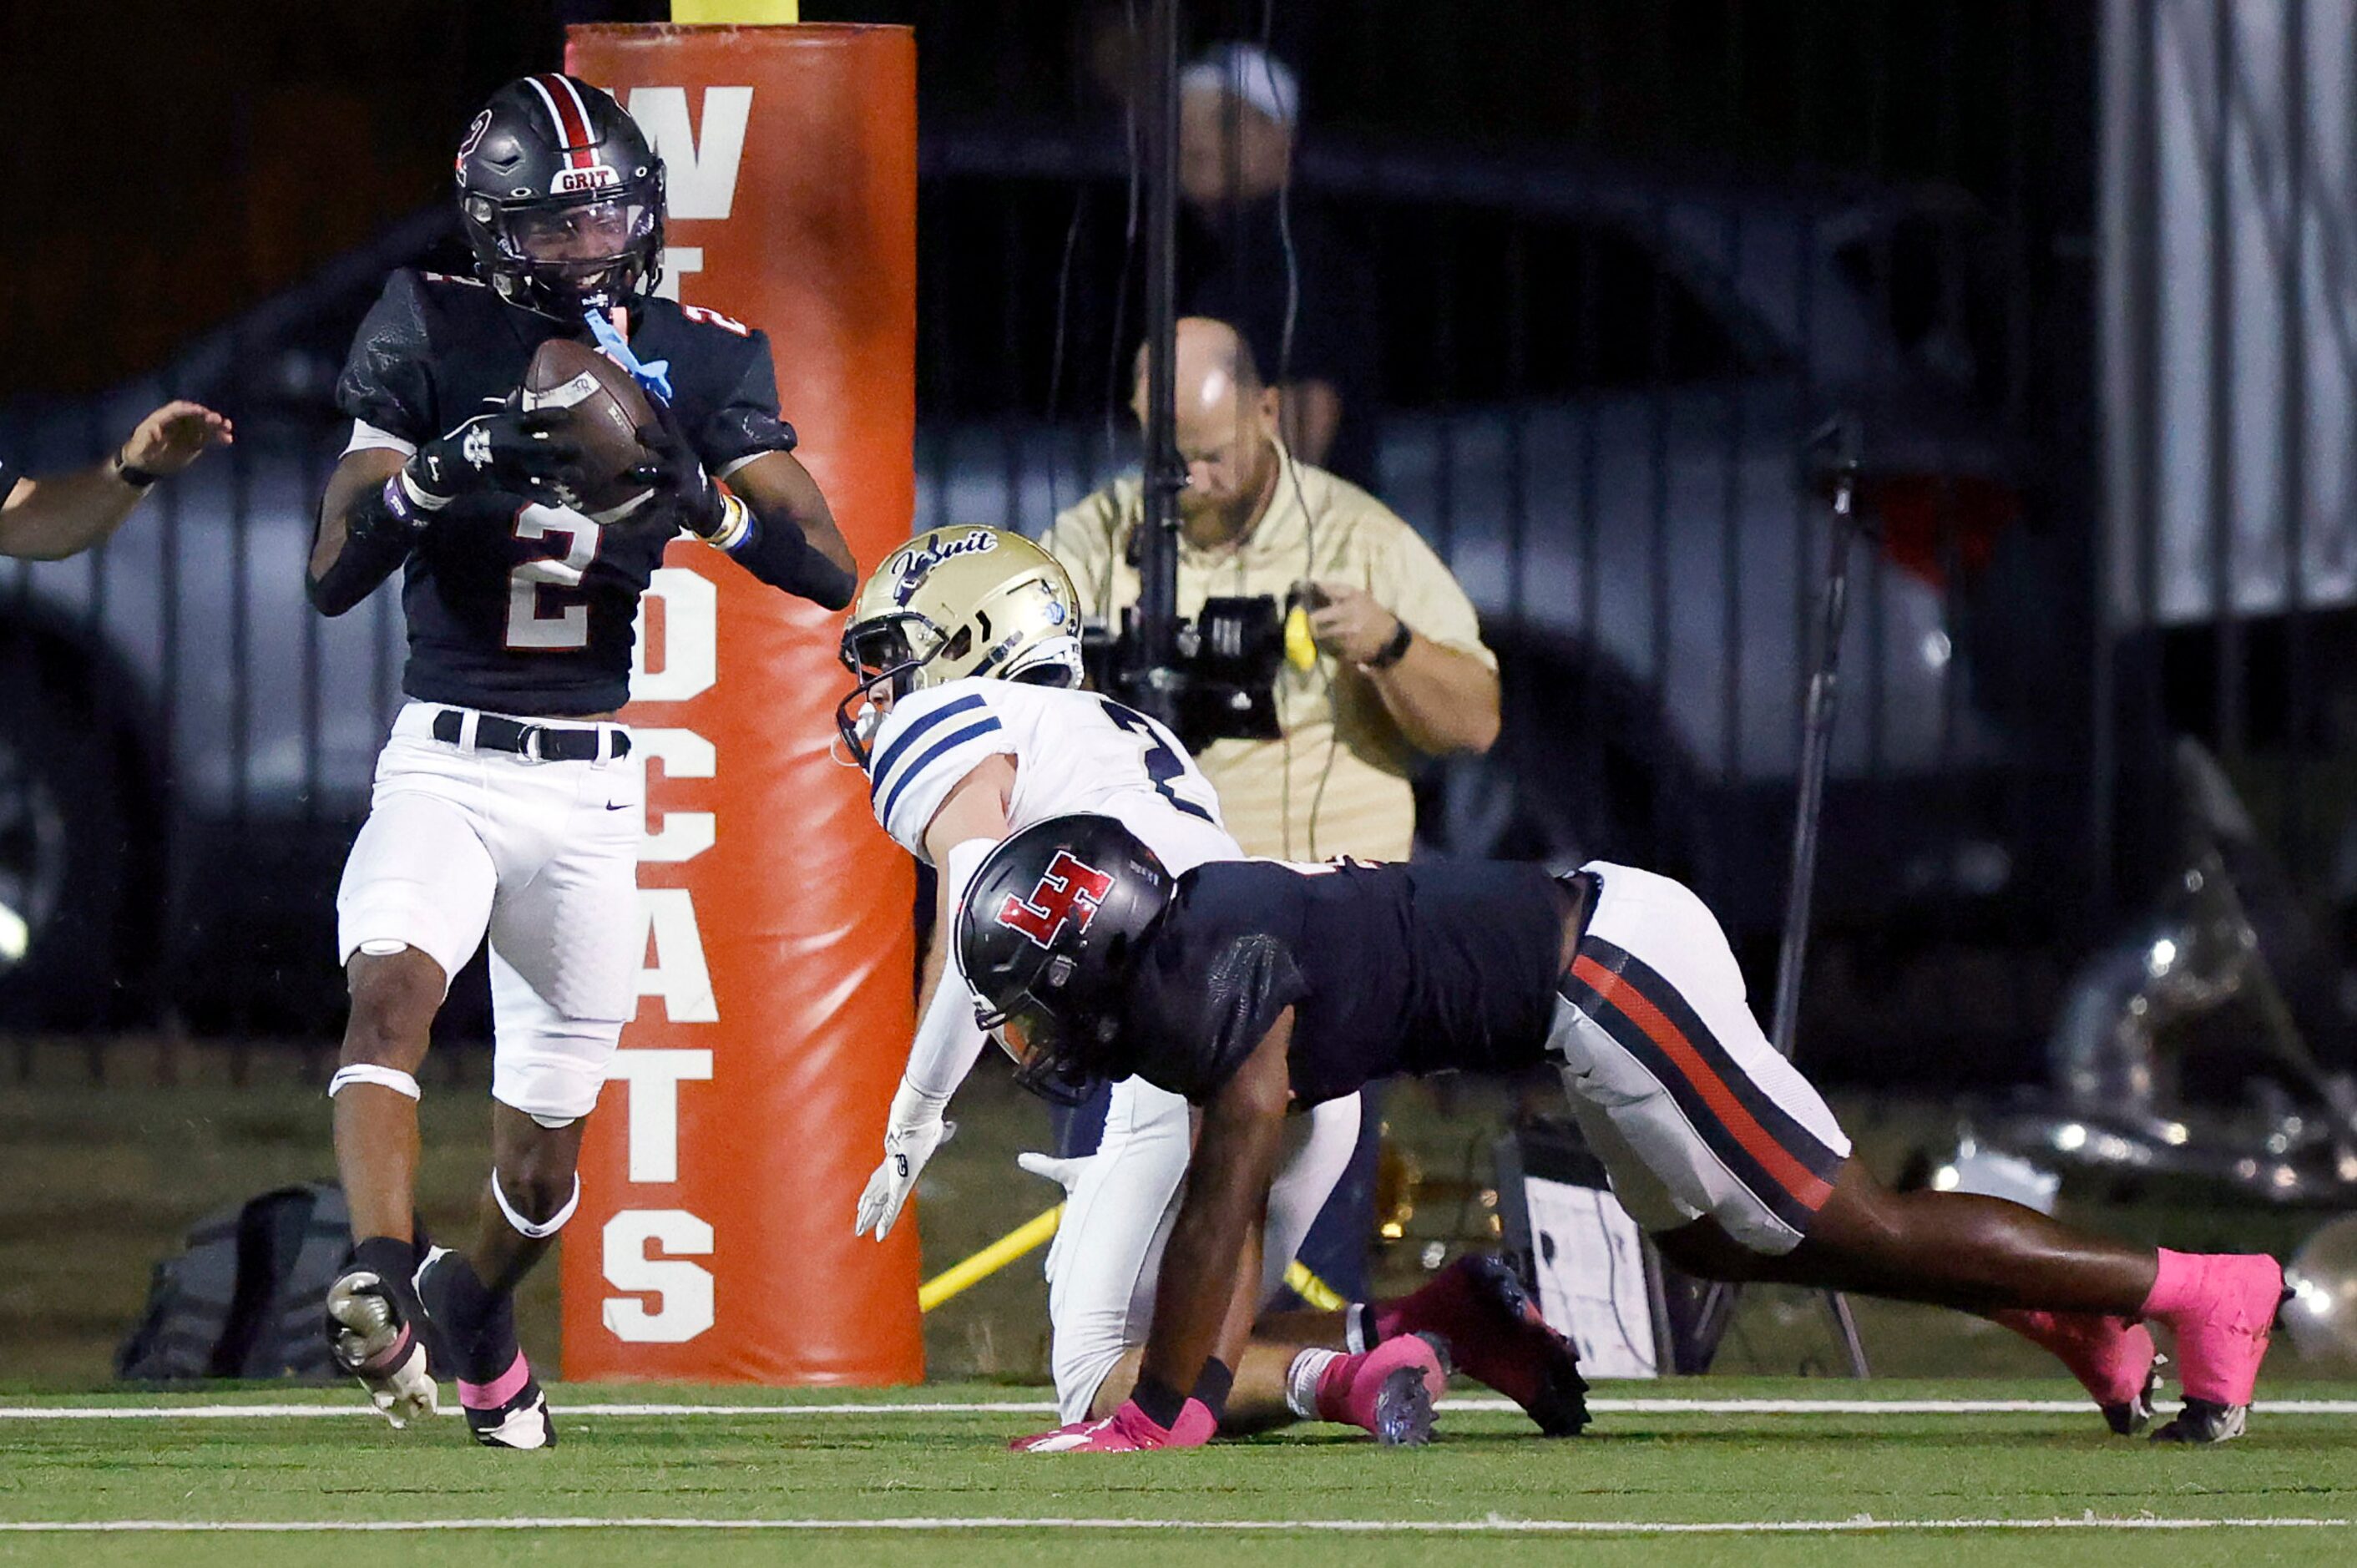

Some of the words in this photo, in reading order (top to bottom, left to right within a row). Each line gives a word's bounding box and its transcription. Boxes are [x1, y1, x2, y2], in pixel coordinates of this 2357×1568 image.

[561, 169, 609, 191] GRIT
[504, 501, 604, 650] 2
[599, 86, 754, 1343] WDCATS
[994, 850, 1115, 950] LH
